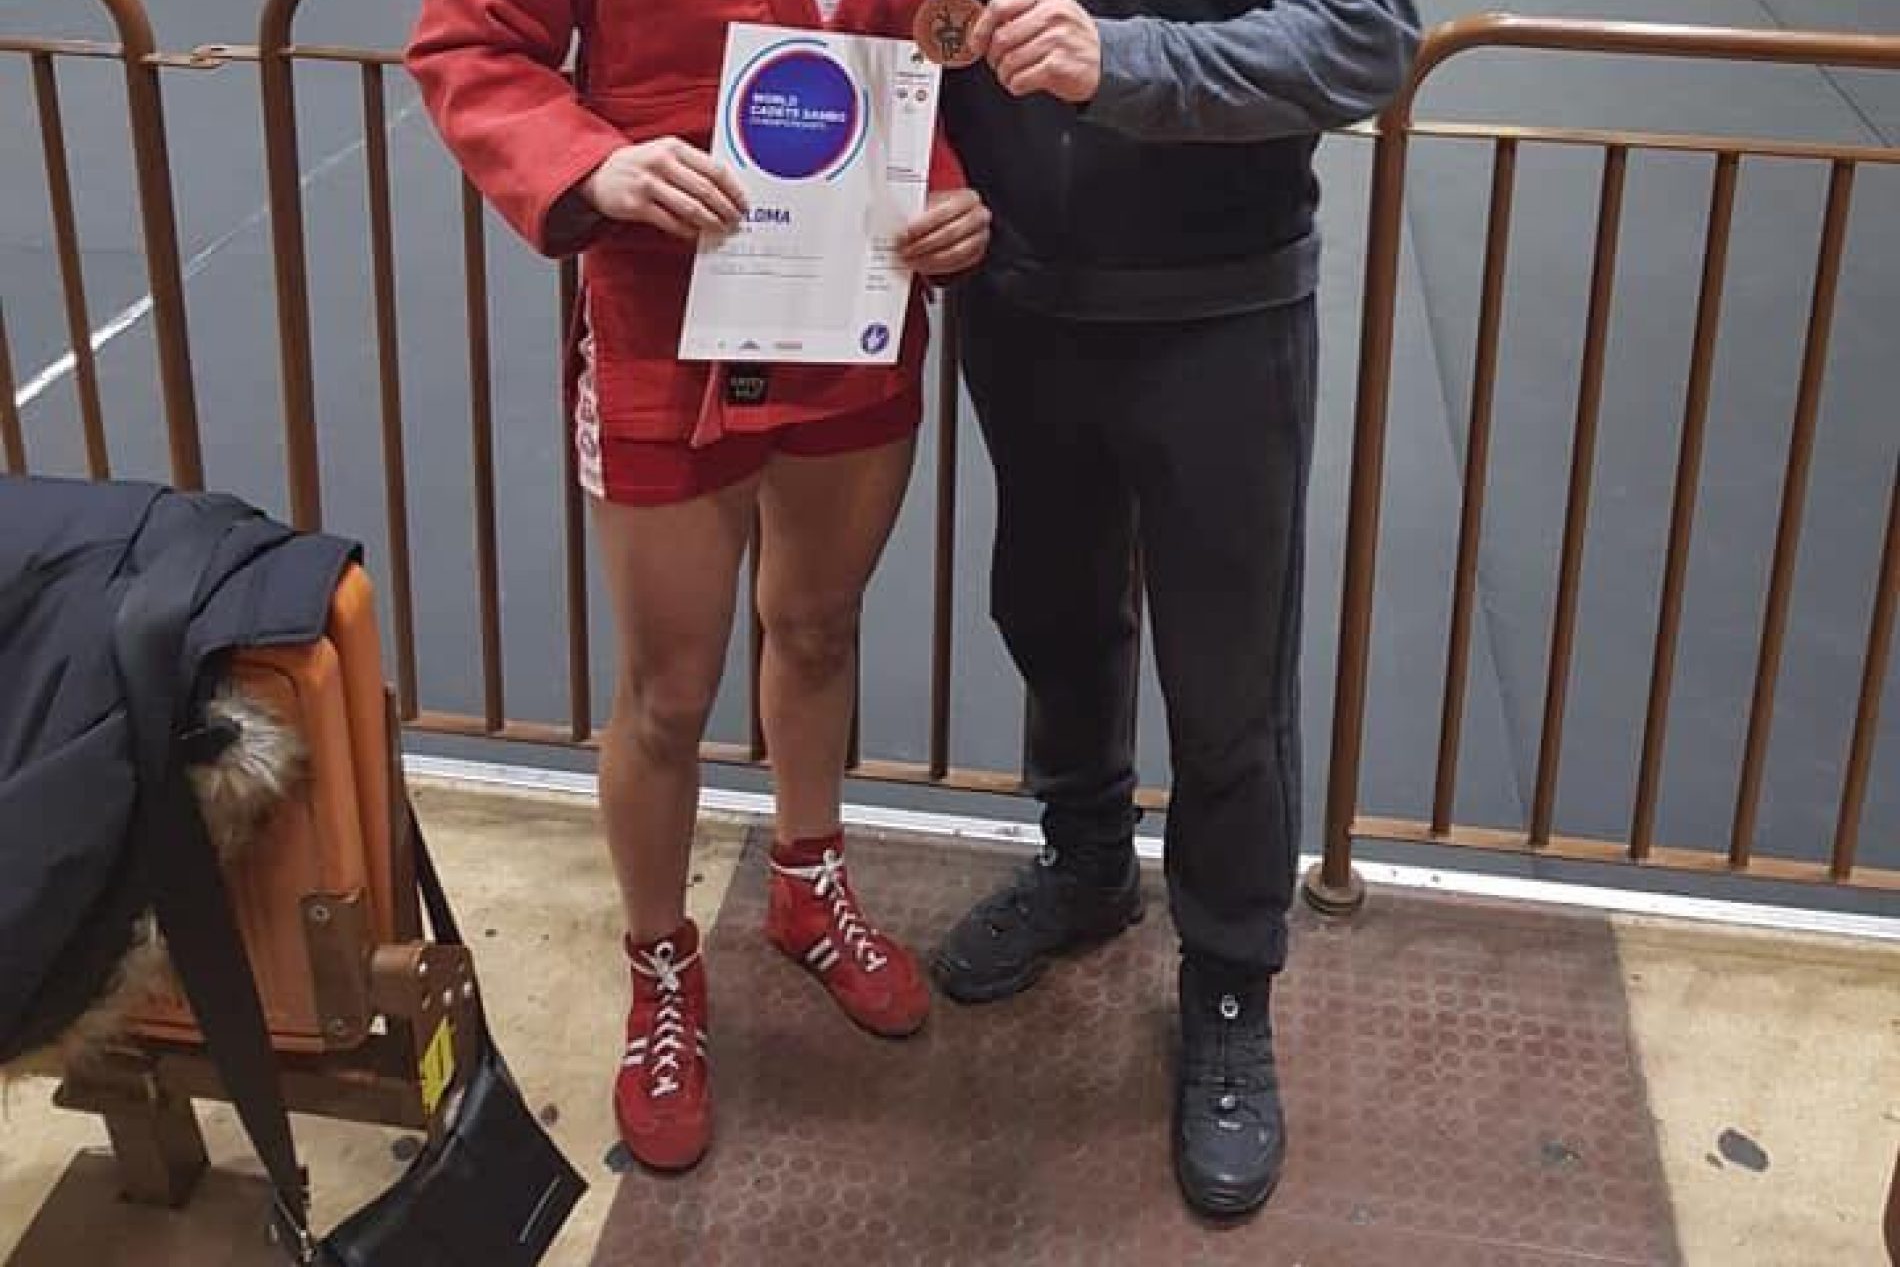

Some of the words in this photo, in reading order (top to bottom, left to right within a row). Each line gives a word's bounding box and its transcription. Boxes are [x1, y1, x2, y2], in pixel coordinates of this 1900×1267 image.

[752, 93, 798, 107] WORLD
[750, 105, 800, 119] CADETS
[745, 208, 790, 224] LOMA
